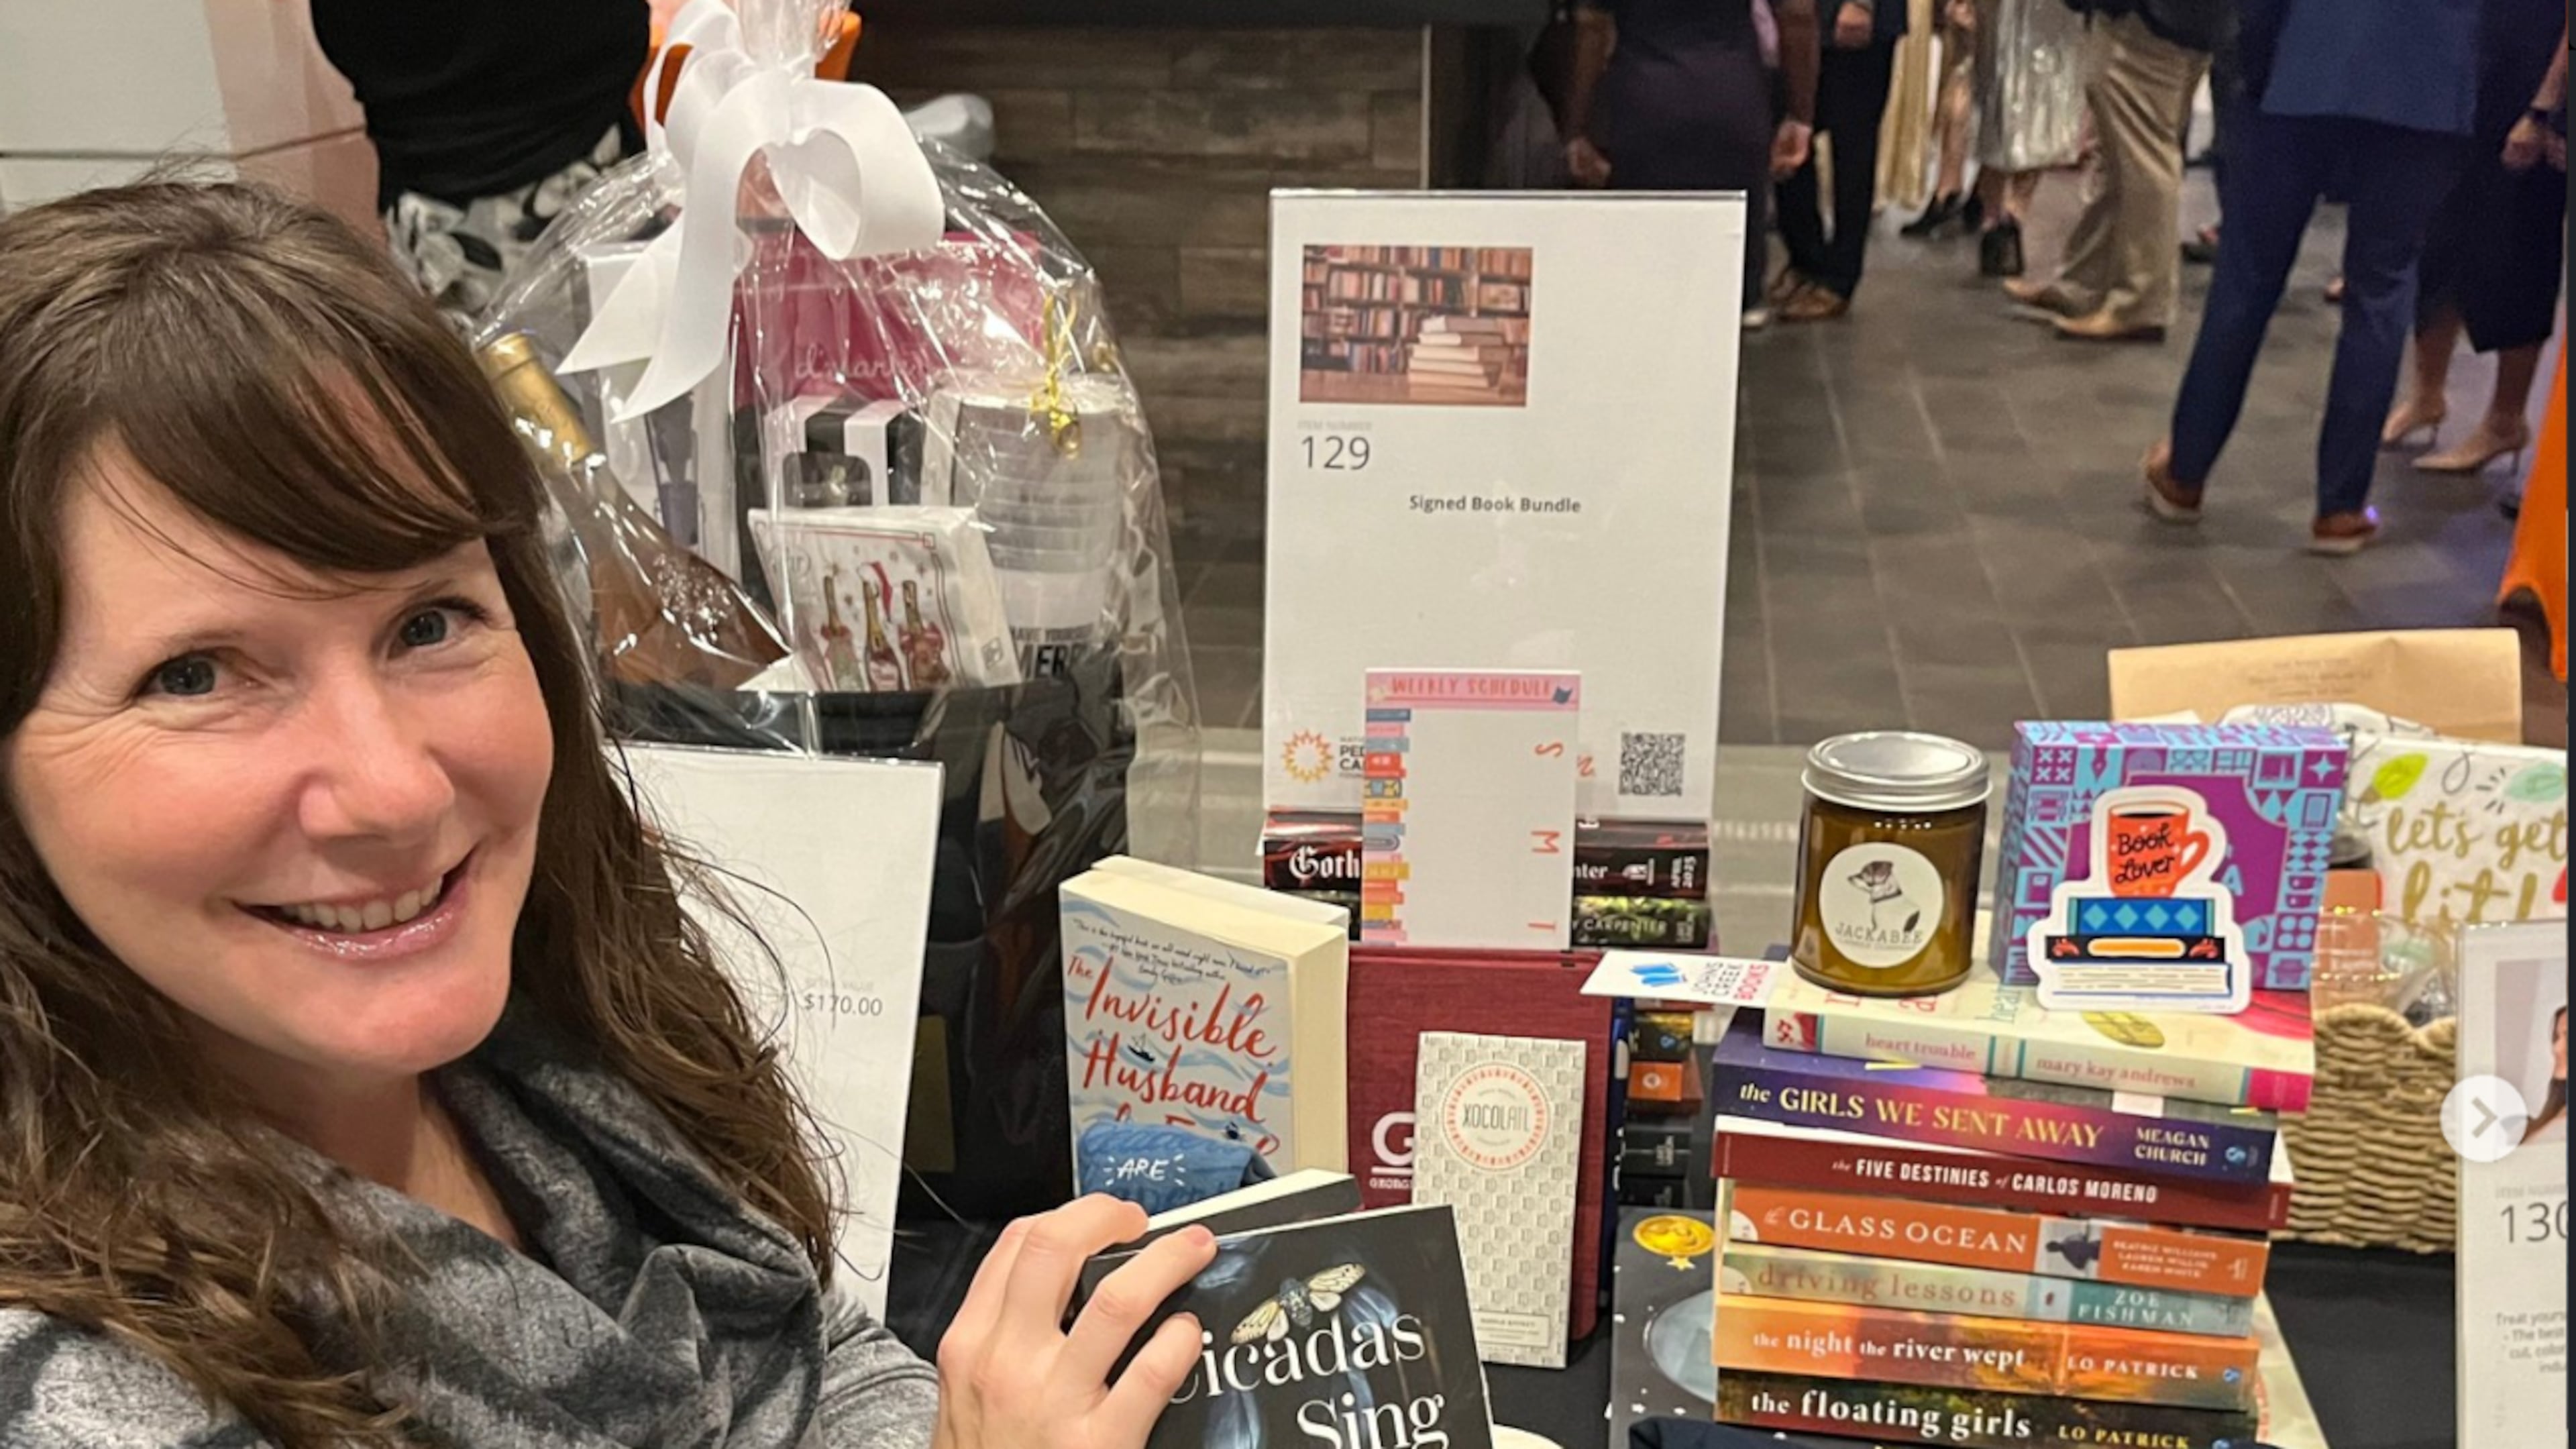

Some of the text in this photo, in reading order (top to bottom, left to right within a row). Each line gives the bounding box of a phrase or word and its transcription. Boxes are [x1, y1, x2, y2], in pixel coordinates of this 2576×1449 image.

[1301, 435, 1371, 470] 129
[1409, 496, 1582, 514] Signed Book Bundle
[1392, 678, 1550, 696] WEEKLY SCHEDULE
[2117, 822, 2174, 856] Book
[2387, 802, 2567, 869] let's get
[2115, 856, 2175, 883] Lover
[1067, 954, 1094, 980] The
[804, 994, 883, 1016] $170.00
[1085, 956, 1277, 1059] Invisible
[1083, 1030, 1269, 1123] Husband
[1865, 1032, 2196, 1088] heart trouble mary kay andrews
[1739, 1083, 2104, 1149] the GIRLS WE SENT AWAY
[2135, 1126, 2210, 1148] MEAGAN
[1116, 1157, 1170, 1181] ARE
[2135, 1144, 2207, 1166] CHURCH
[1856, 1158, 1894, 1179] FIVE
[1900, 1163, 1990, 1188] DESTINIES
[2012, 1173, 2079, 1197] CARLOS
[2084, 1179, 2158, 1203] MORENO
[1789, 1209, 1896, 1240] GLASS
[1905, 1221, 2028, 1254] OCEAN
[1758, 1263, 2017, 1306] driving lessons
[2114, 1289, 2161, 1307] ZOE
[2078, 1304, 2194, 1326] FISHMAN
[1168, 1313, 1427, 1404] icadas
[1753, 1330, 2025, 1373] the night the river wept
[2068, 1356, 2199, 1380] LO PATRICK
[1296, 1393, 1450, 1449] Sing
[1751, 1389, 2032, 1441] the floating girls
[2058, 1424, 2191, 1449] LO PATRICK
